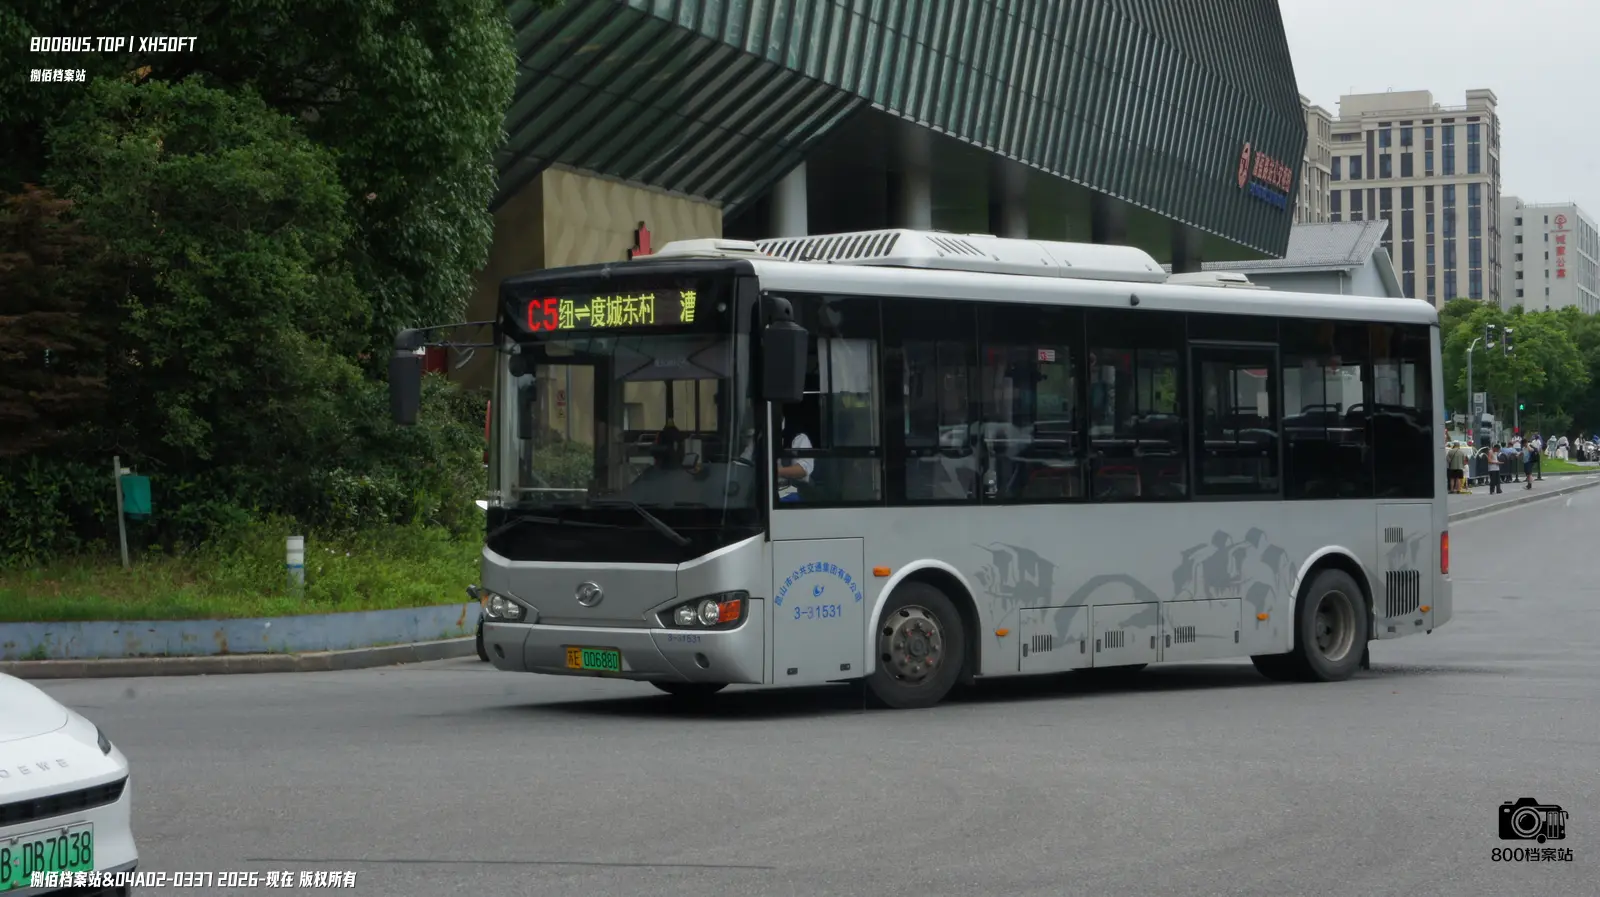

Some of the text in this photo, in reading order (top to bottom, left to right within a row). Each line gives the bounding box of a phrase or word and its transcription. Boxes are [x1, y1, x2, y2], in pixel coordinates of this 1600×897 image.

[528, 297, 558, 331] C5
[590, 293, 655, 328] 度城东村
[774, 561, 863, 607] 昆山市公共交通集团有限公司
[794, 604, 842, 620] 3-31531
